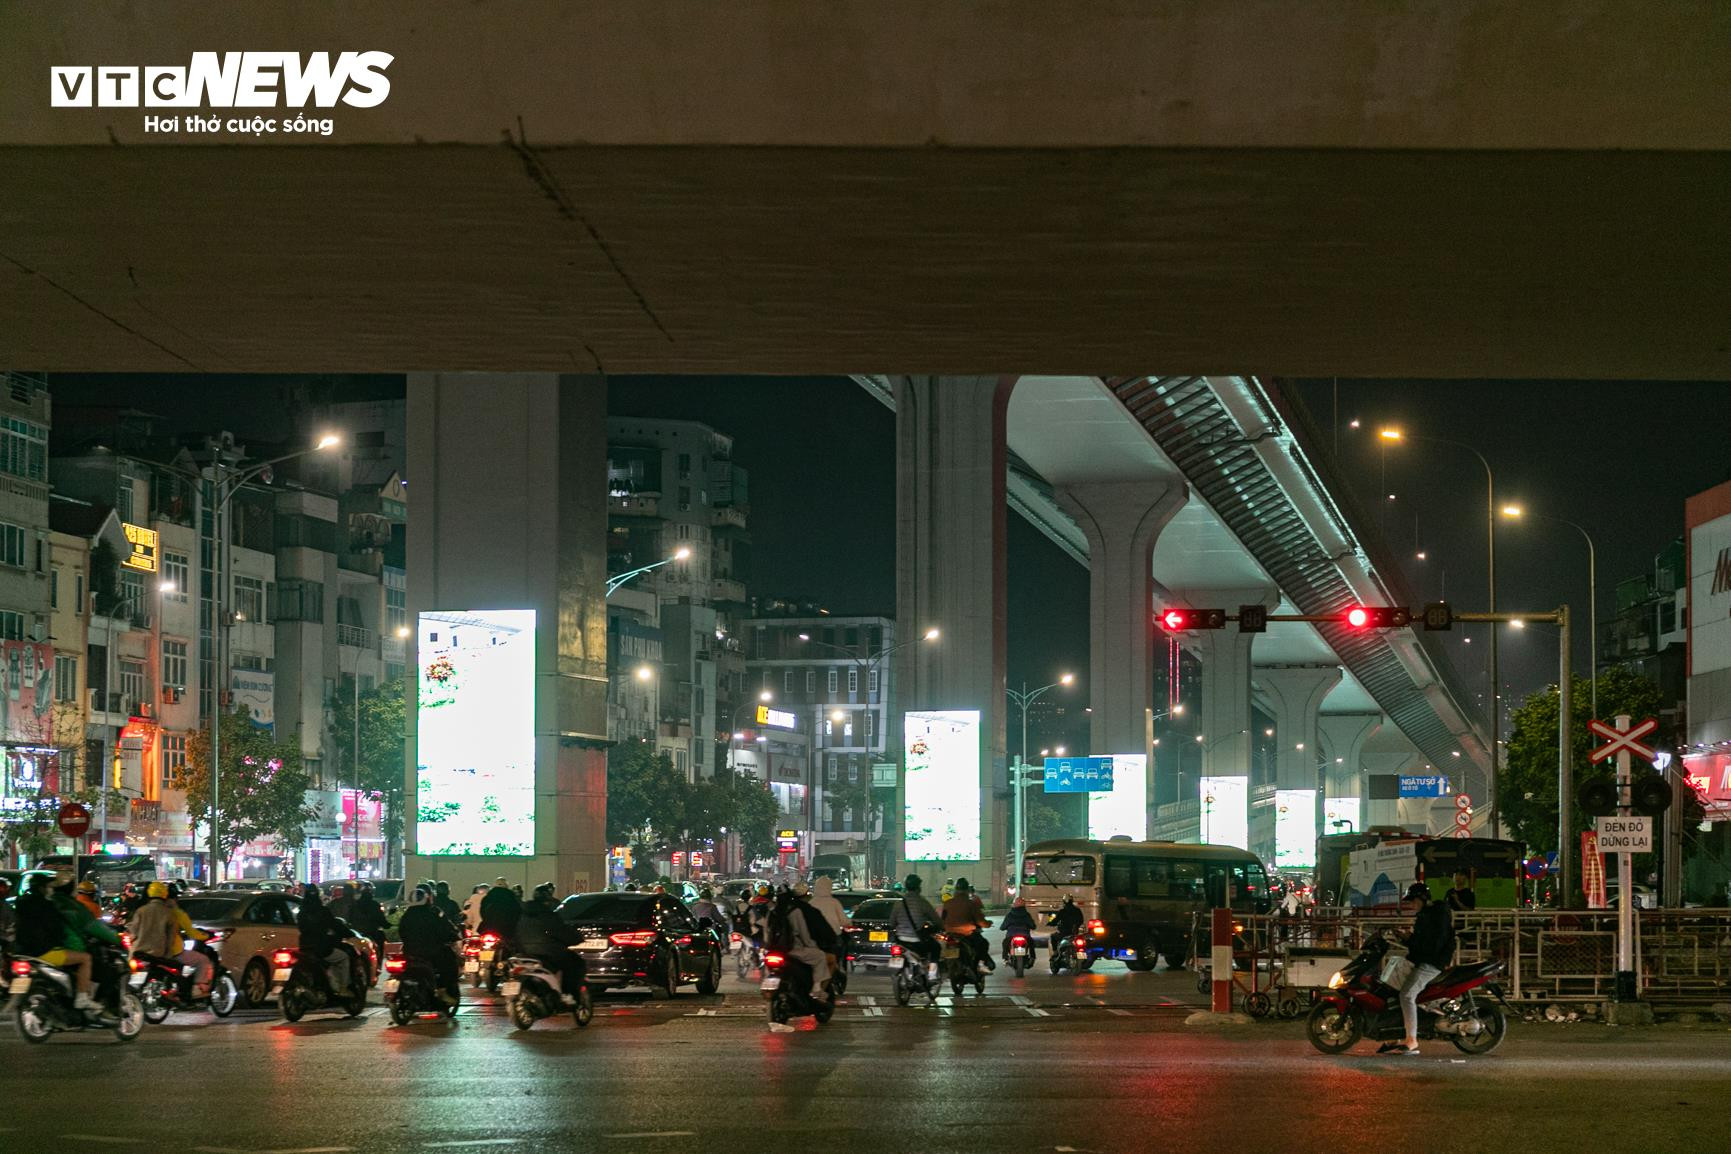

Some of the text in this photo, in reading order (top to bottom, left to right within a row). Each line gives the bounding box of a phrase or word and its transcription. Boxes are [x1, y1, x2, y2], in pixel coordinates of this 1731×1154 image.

[1605, 818, 1644, 832] ĐÈN ĐỎ
[1601, 834, 1648, 848] DỪNG LẠI
